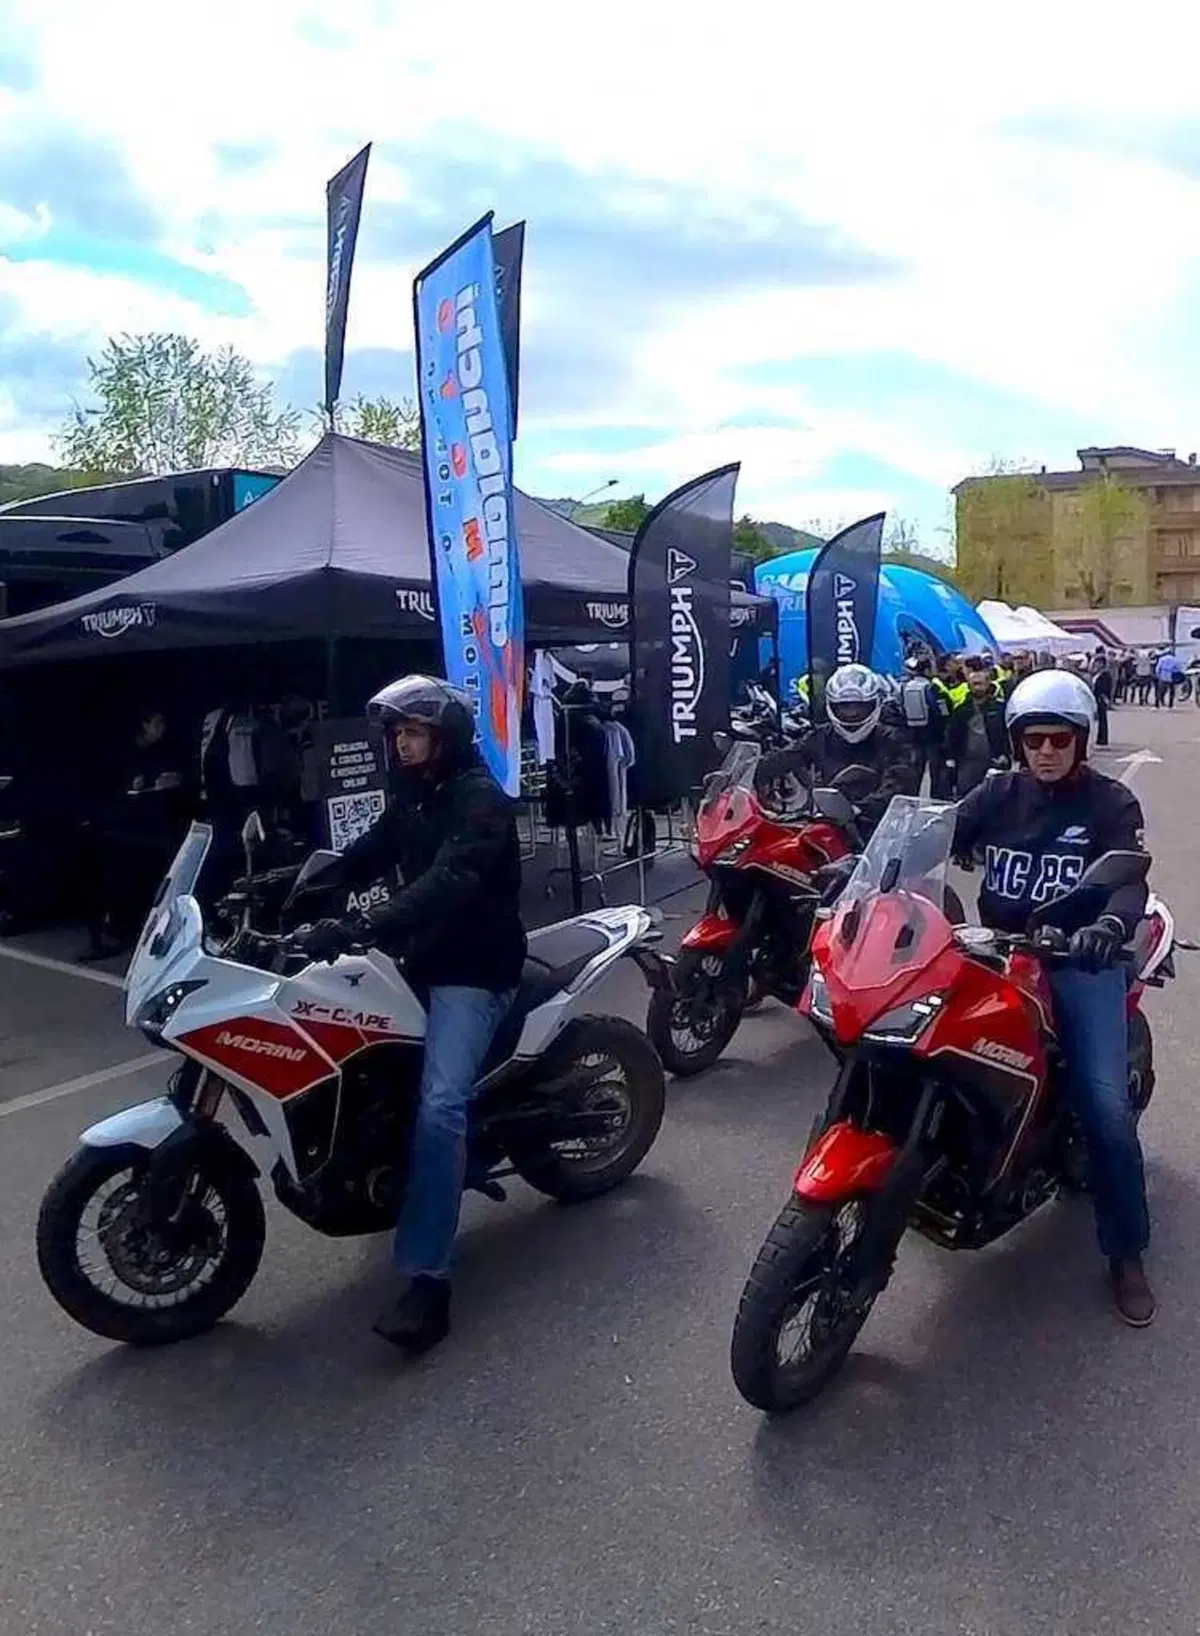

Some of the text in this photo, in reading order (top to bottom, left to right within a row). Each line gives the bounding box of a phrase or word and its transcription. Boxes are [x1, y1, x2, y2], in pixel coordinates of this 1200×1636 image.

[81, 606, 143, 637] TRIUMPH
[671, 587, 704, 743] TRIUMPH
[985, 845, 1032, 899] MC
[346, 884, 389, 912] Agos
[290, 999, 391, 1030] X-CAPE
[215, 1031, 307, 1062] MORINI
